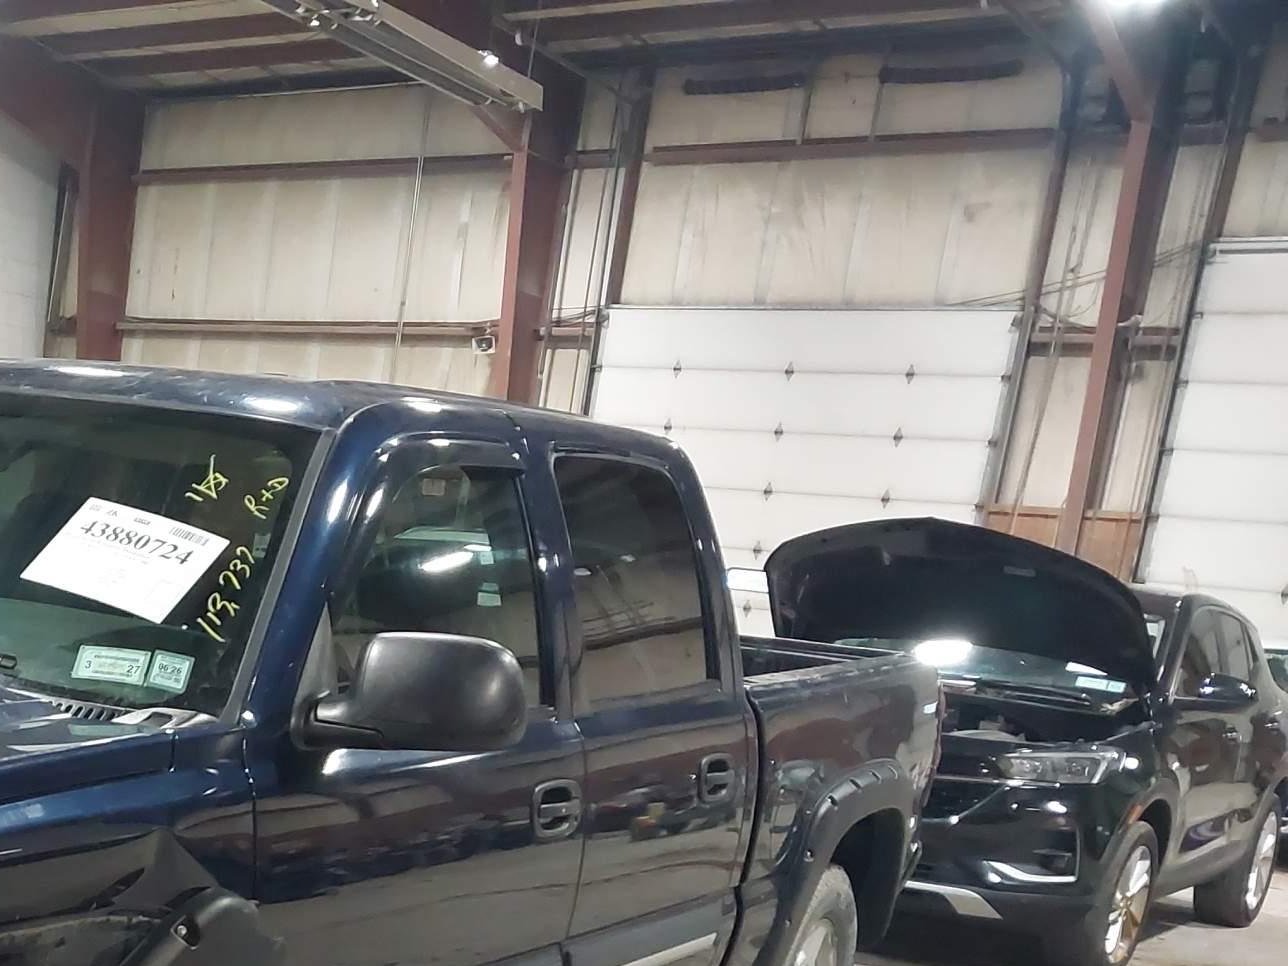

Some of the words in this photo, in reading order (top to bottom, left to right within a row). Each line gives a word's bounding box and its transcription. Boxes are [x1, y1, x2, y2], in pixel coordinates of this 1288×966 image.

[80, 520, 195, 565] 43880724
[84, 660, 92, 669] 3
[126, 664, 141, 674] 27
